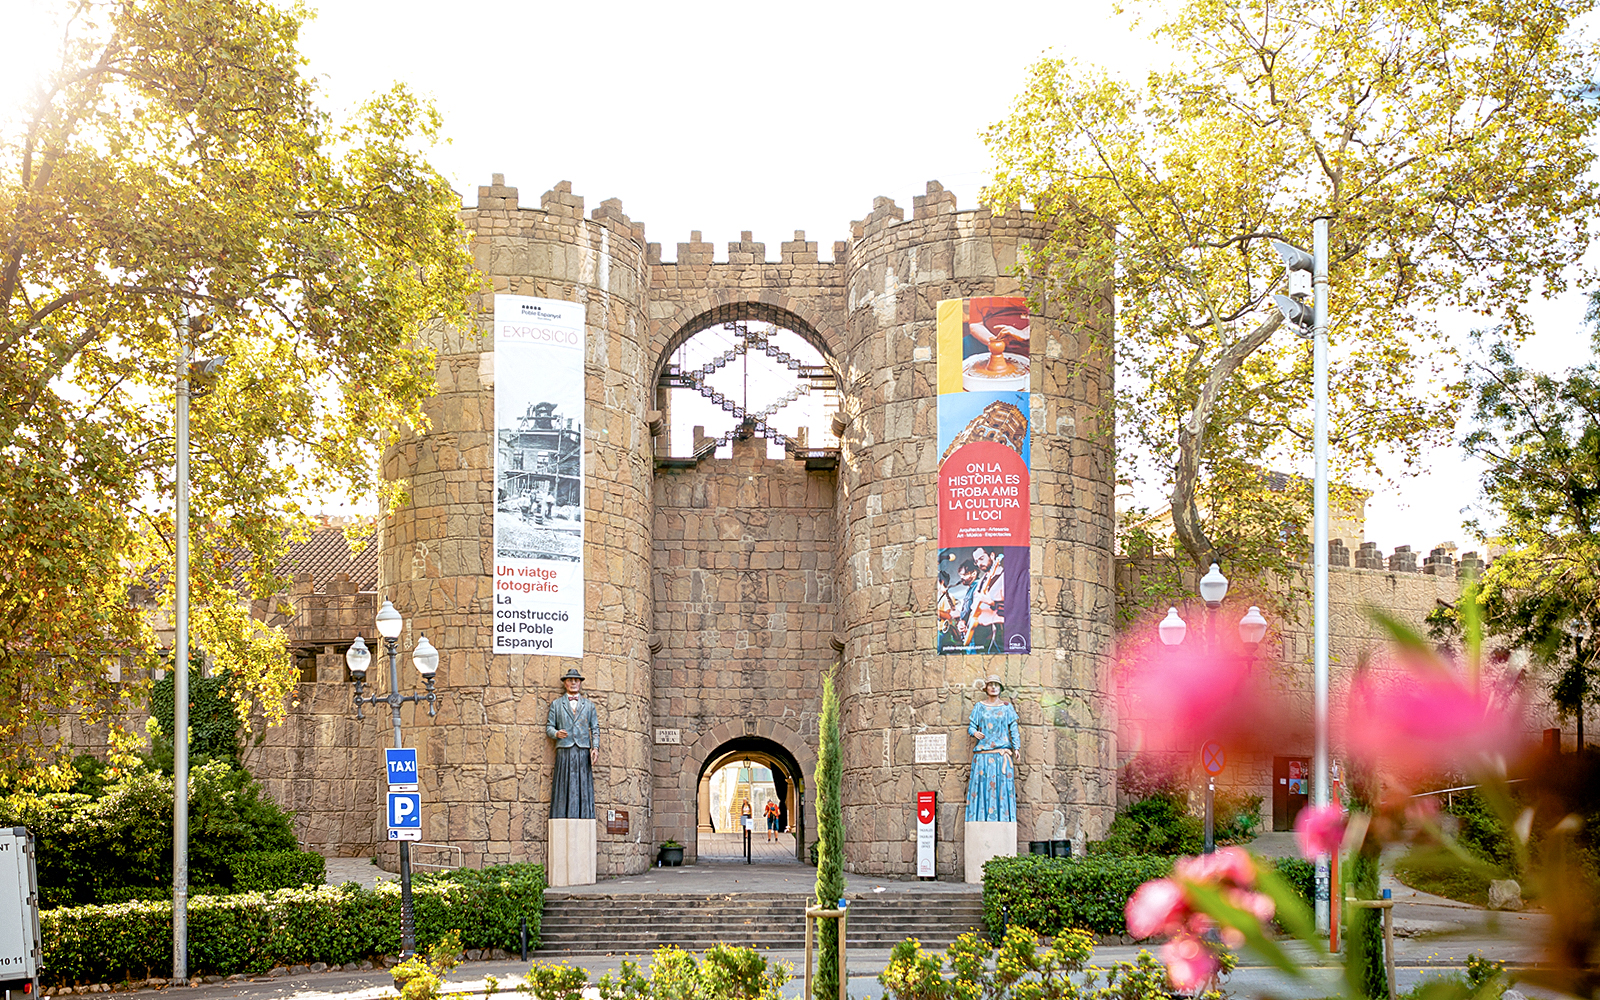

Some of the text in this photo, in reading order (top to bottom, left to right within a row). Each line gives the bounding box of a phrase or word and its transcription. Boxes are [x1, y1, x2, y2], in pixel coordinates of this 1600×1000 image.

[503, 326, 578, 345] EXPOSICIÓ
[966, 463, 1002, 473] ON LA
[949, 473, 1020, 486] HISTÒRIA ES
[950, 486, 1018, 498] TROBA AMB
[949, 499, 1020, 510] LA CULTURA
[966, 510, 1002, 520] I L'OCI
[497, 566, 557, 580] Un viatge
[497, 580, 558, 593] fotogràfic
[497, 594, 511, 604] La
[497, 609, 568, 622] construcció
[497, 622, 553, 634] del Poble
[497, 636, 553, 650] Espanyol
[389, 761, 415, 772] TAXI
[394, 796, 414, 825] P
[13, 956, 23, 964] 11
